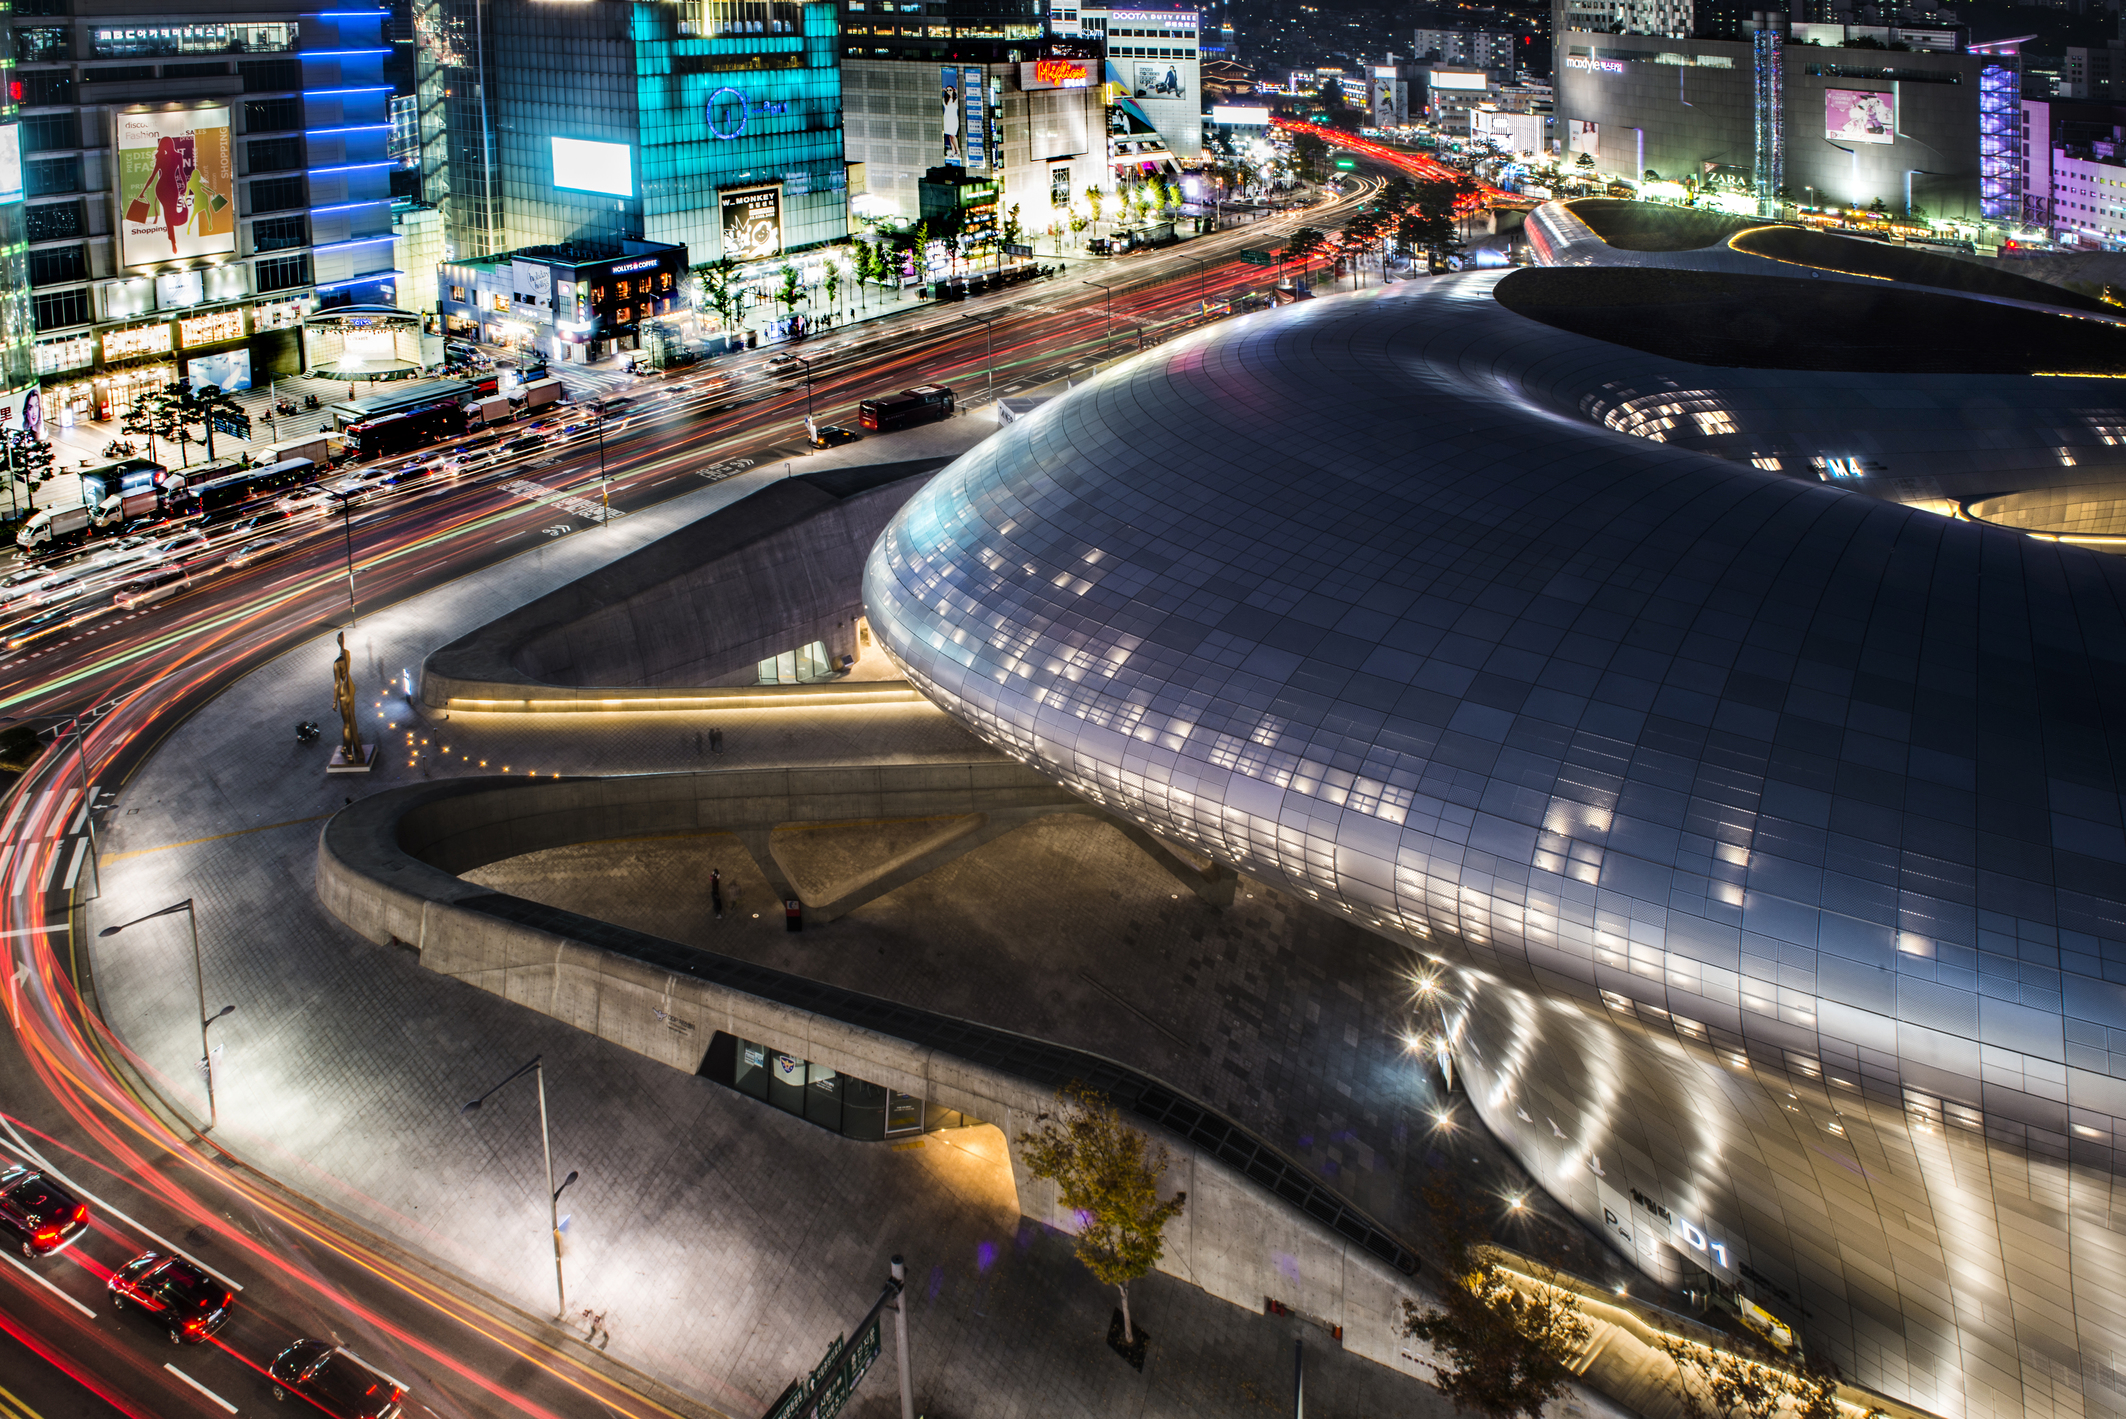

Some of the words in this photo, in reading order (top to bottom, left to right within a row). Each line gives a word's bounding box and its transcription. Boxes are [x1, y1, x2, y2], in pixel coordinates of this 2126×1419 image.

[1112, 12, 1148, 20] DOOTA
[125, 131, 160, 140] Fashion
[219, 127, 229, 179] SHOPPING
[1708, 172, 1746, 186] ZARA
[131, 226, 168, 236] Shopping
[1826, 457, 1863, 477] M4
[1603, 1207, 1618, 1225] P
[1681, 1218, 1728, 1268] D1
